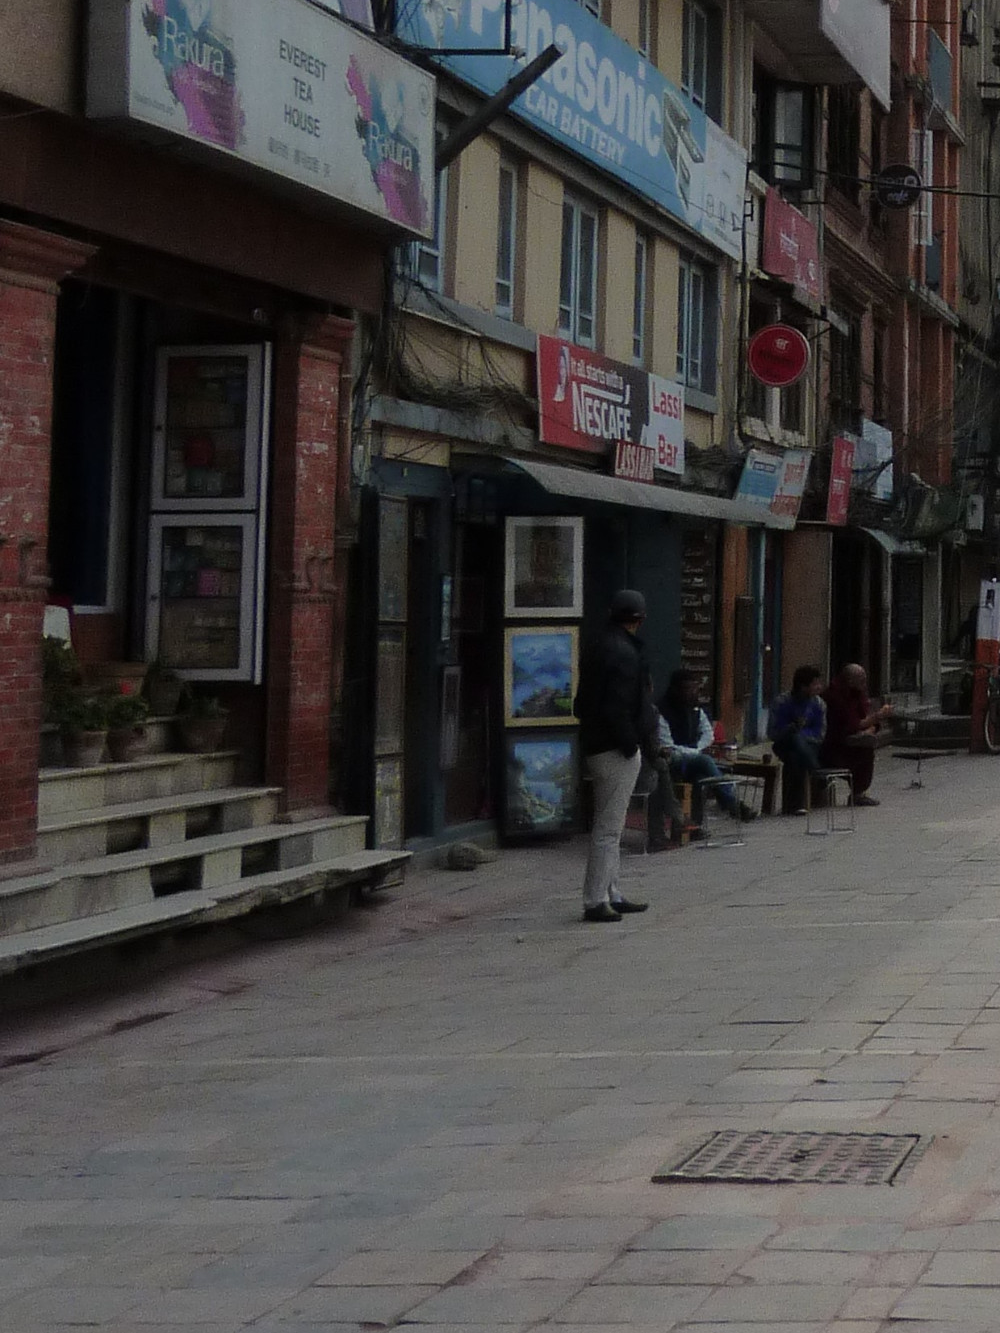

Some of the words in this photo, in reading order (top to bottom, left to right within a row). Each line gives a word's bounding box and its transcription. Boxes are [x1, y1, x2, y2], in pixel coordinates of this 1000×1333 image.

[164, 15, 225, 78] Rakura
[279, 39, 327, 81] EVEREST
[293, 77, 312, 104] TEA
[284, 103, 321, 138] HOUSE
[524, 84, 559, 128] CAR
[560, 103, 626, 164] BATTERY
[370, 121, 412, 172] Rakura
[652, 381, 682, 421] Lassi
[658, 434, 678, 468] Bar
